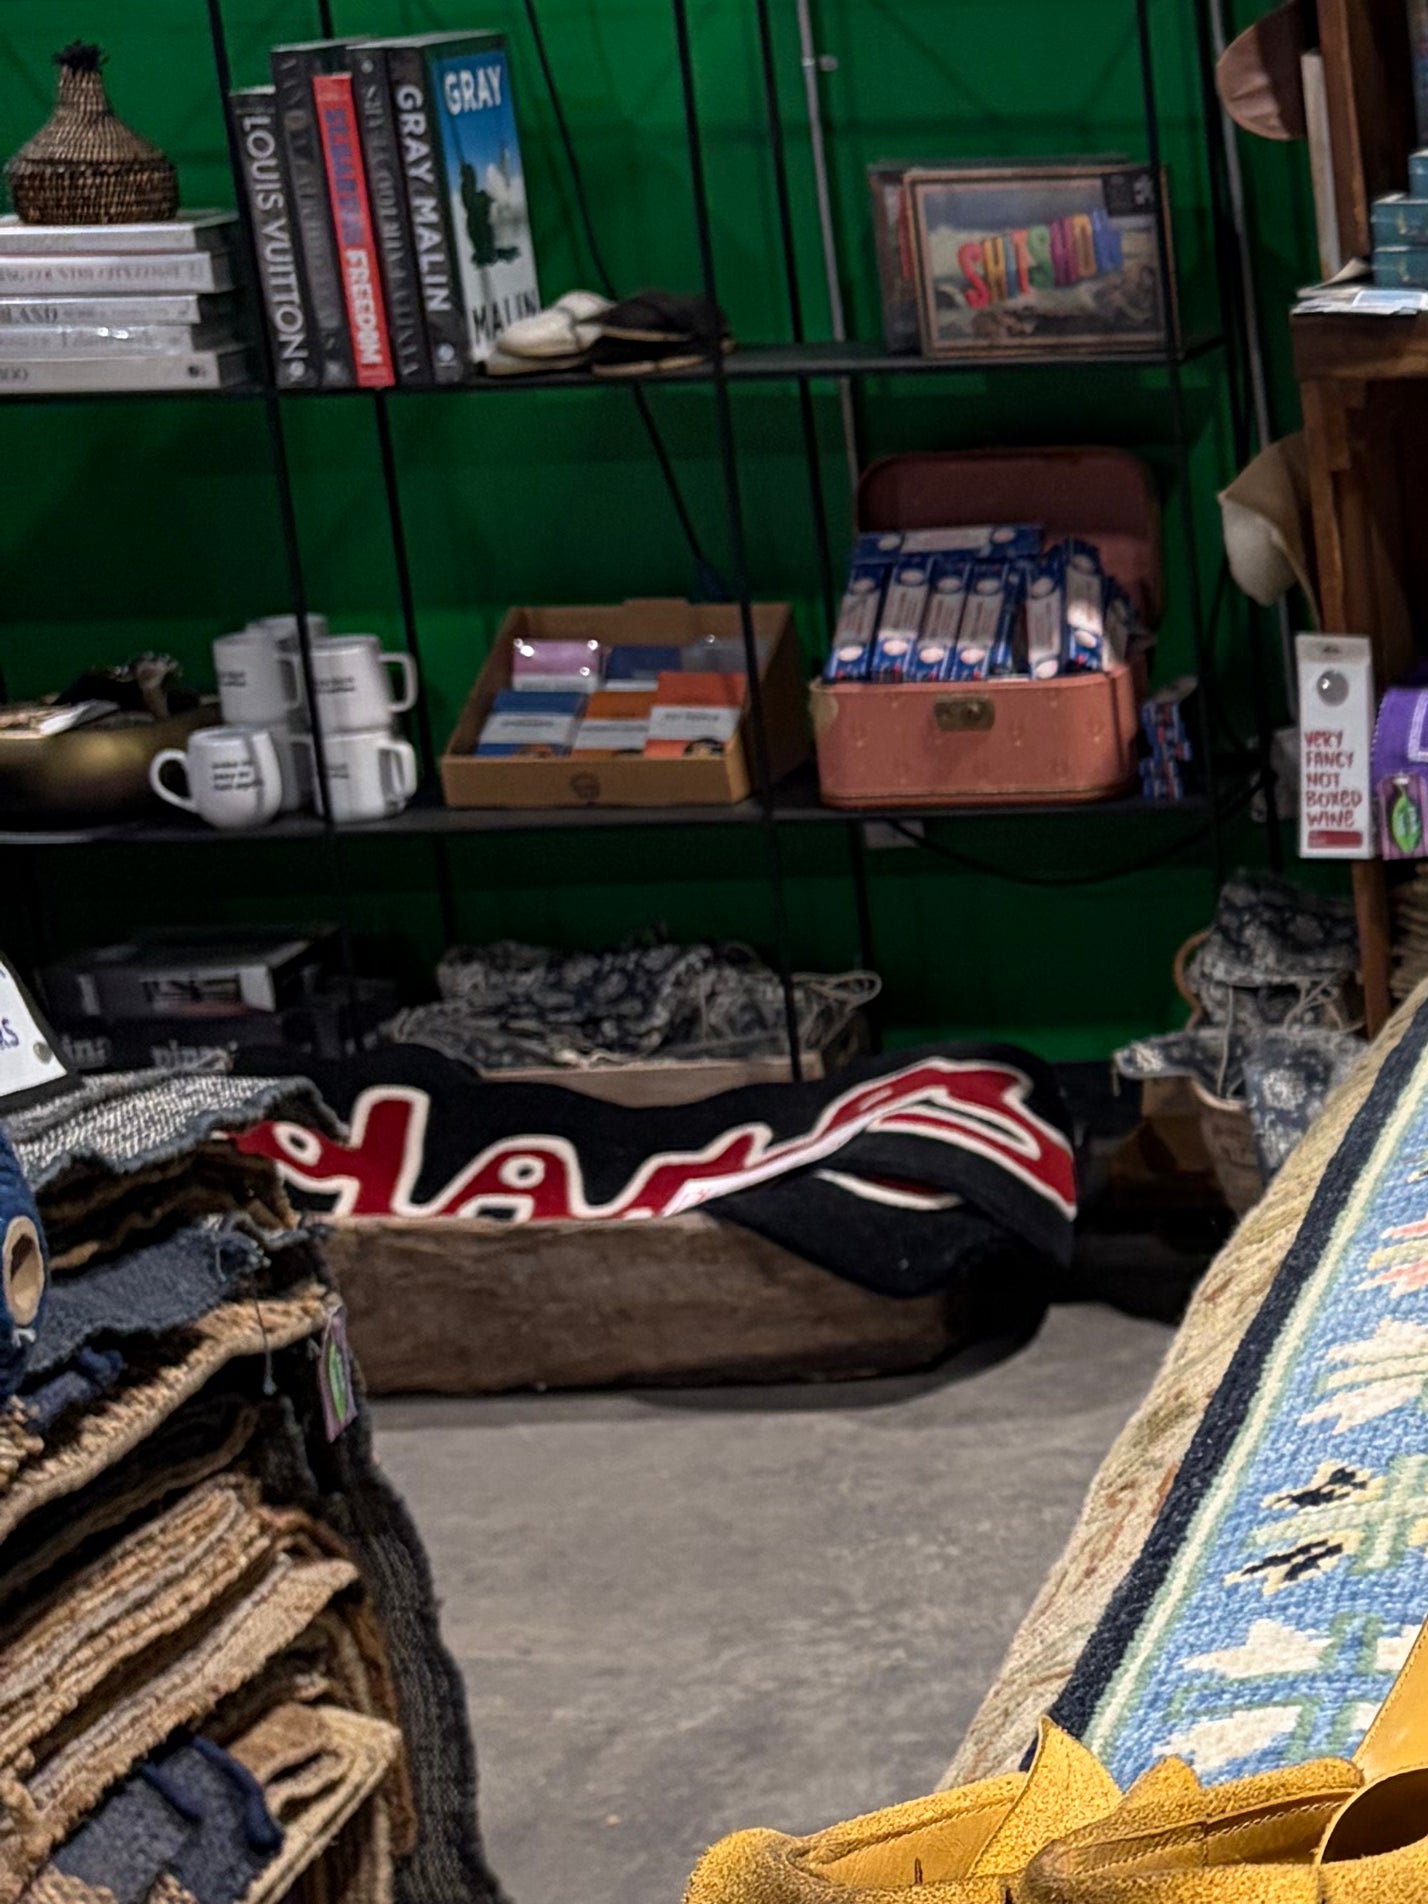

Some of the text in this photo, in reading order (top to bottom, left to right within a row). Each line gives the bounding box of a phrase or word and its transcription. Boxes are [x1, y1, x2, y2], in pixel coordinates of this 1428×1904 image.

[444, 66, 502, 115] GRAY
[242, 115, 284, 211] LOUIS
[263, 219, 308, 361] VUITTON
[397, 84, 451, 312] GRAY MALIN
[345, 249, 382, 365] FREEDOM
[1306, 773, 1340, 789] NOT
